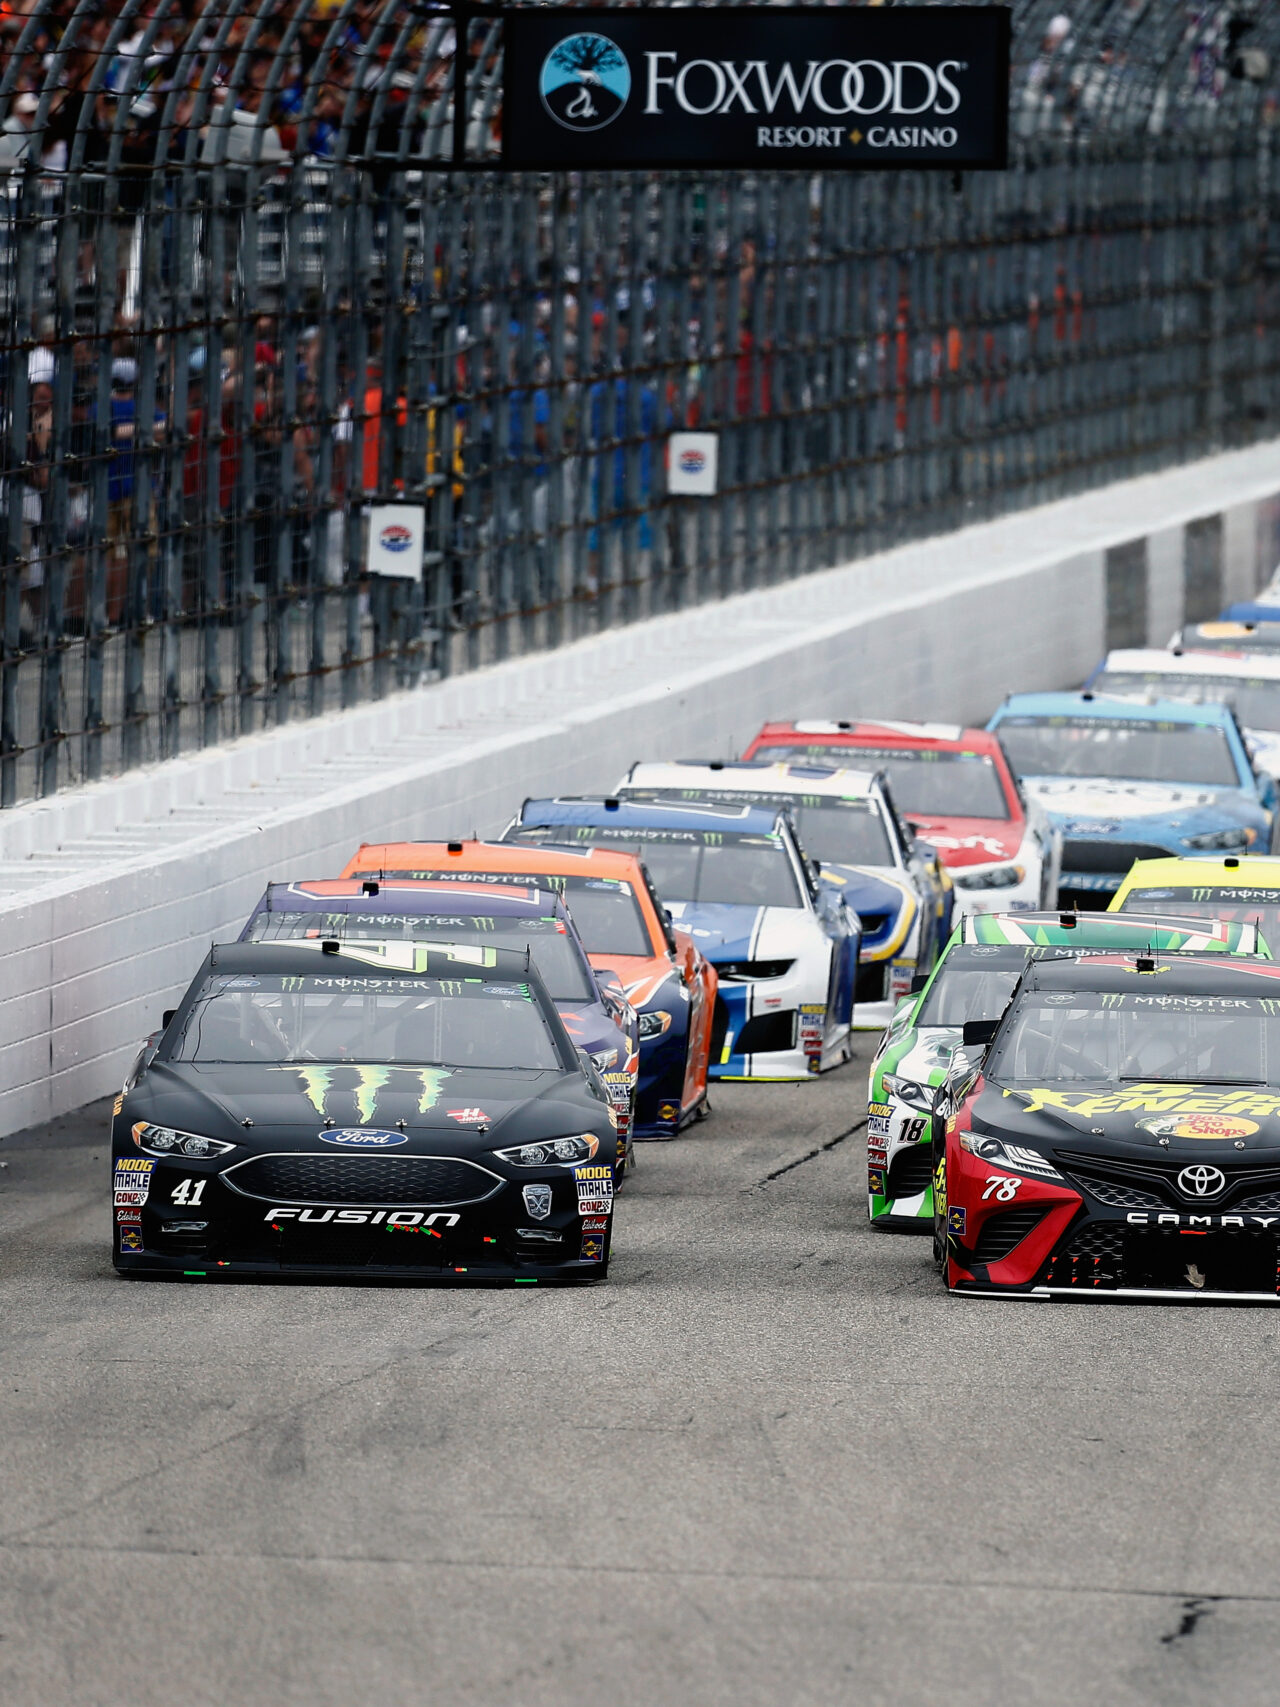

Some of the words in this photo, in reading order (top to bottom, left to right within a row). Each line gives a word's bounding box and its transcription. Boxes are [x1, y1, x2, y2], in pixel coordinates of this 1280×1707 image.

[642, 51, 961, 115] FOXWOODS
[757, 126, 846, 148] RESORT
[867, 126, 958, 148] CASINO
[602, 829, 696, 841] MONSTER
[439, 873, 540, 885] MONSTER
[356, 915, 465, 927] MONSTER
[314, 977, 431, 990] MONSTER
[1135, 996, 1251, 1010] MONSTER
[1162, 1006, 1228, 1014] ENERGY
[603, 1072, 631, 1084] MOOG
[869, 1103, 894, 1117] MOOG
[1187, 1114, 1233, 1122] Bass
[1189, 1120, 1224, 1128] Pro
[898, 1117, 928, 1143] 18
[1188, 1126, 1247, 1137] Shops
[335, 1130, 391, 1145] Ford
[116, 1158, 156, 1172] MOOG
[575, 1166, 612, 1180] MOOG
[114, 1173, 149, 1188] MAHLE
[170, 1178, 207, 1206] 41
[578, 1182, 612, 1197] MAHLE
[982, 1175, 1023, 1202] 78
[580, 1200, 603, 1212] COMP
[264, 1208, 461, 1227] FUSION
[1127, 1212, 1279, 1228] CAMRY
